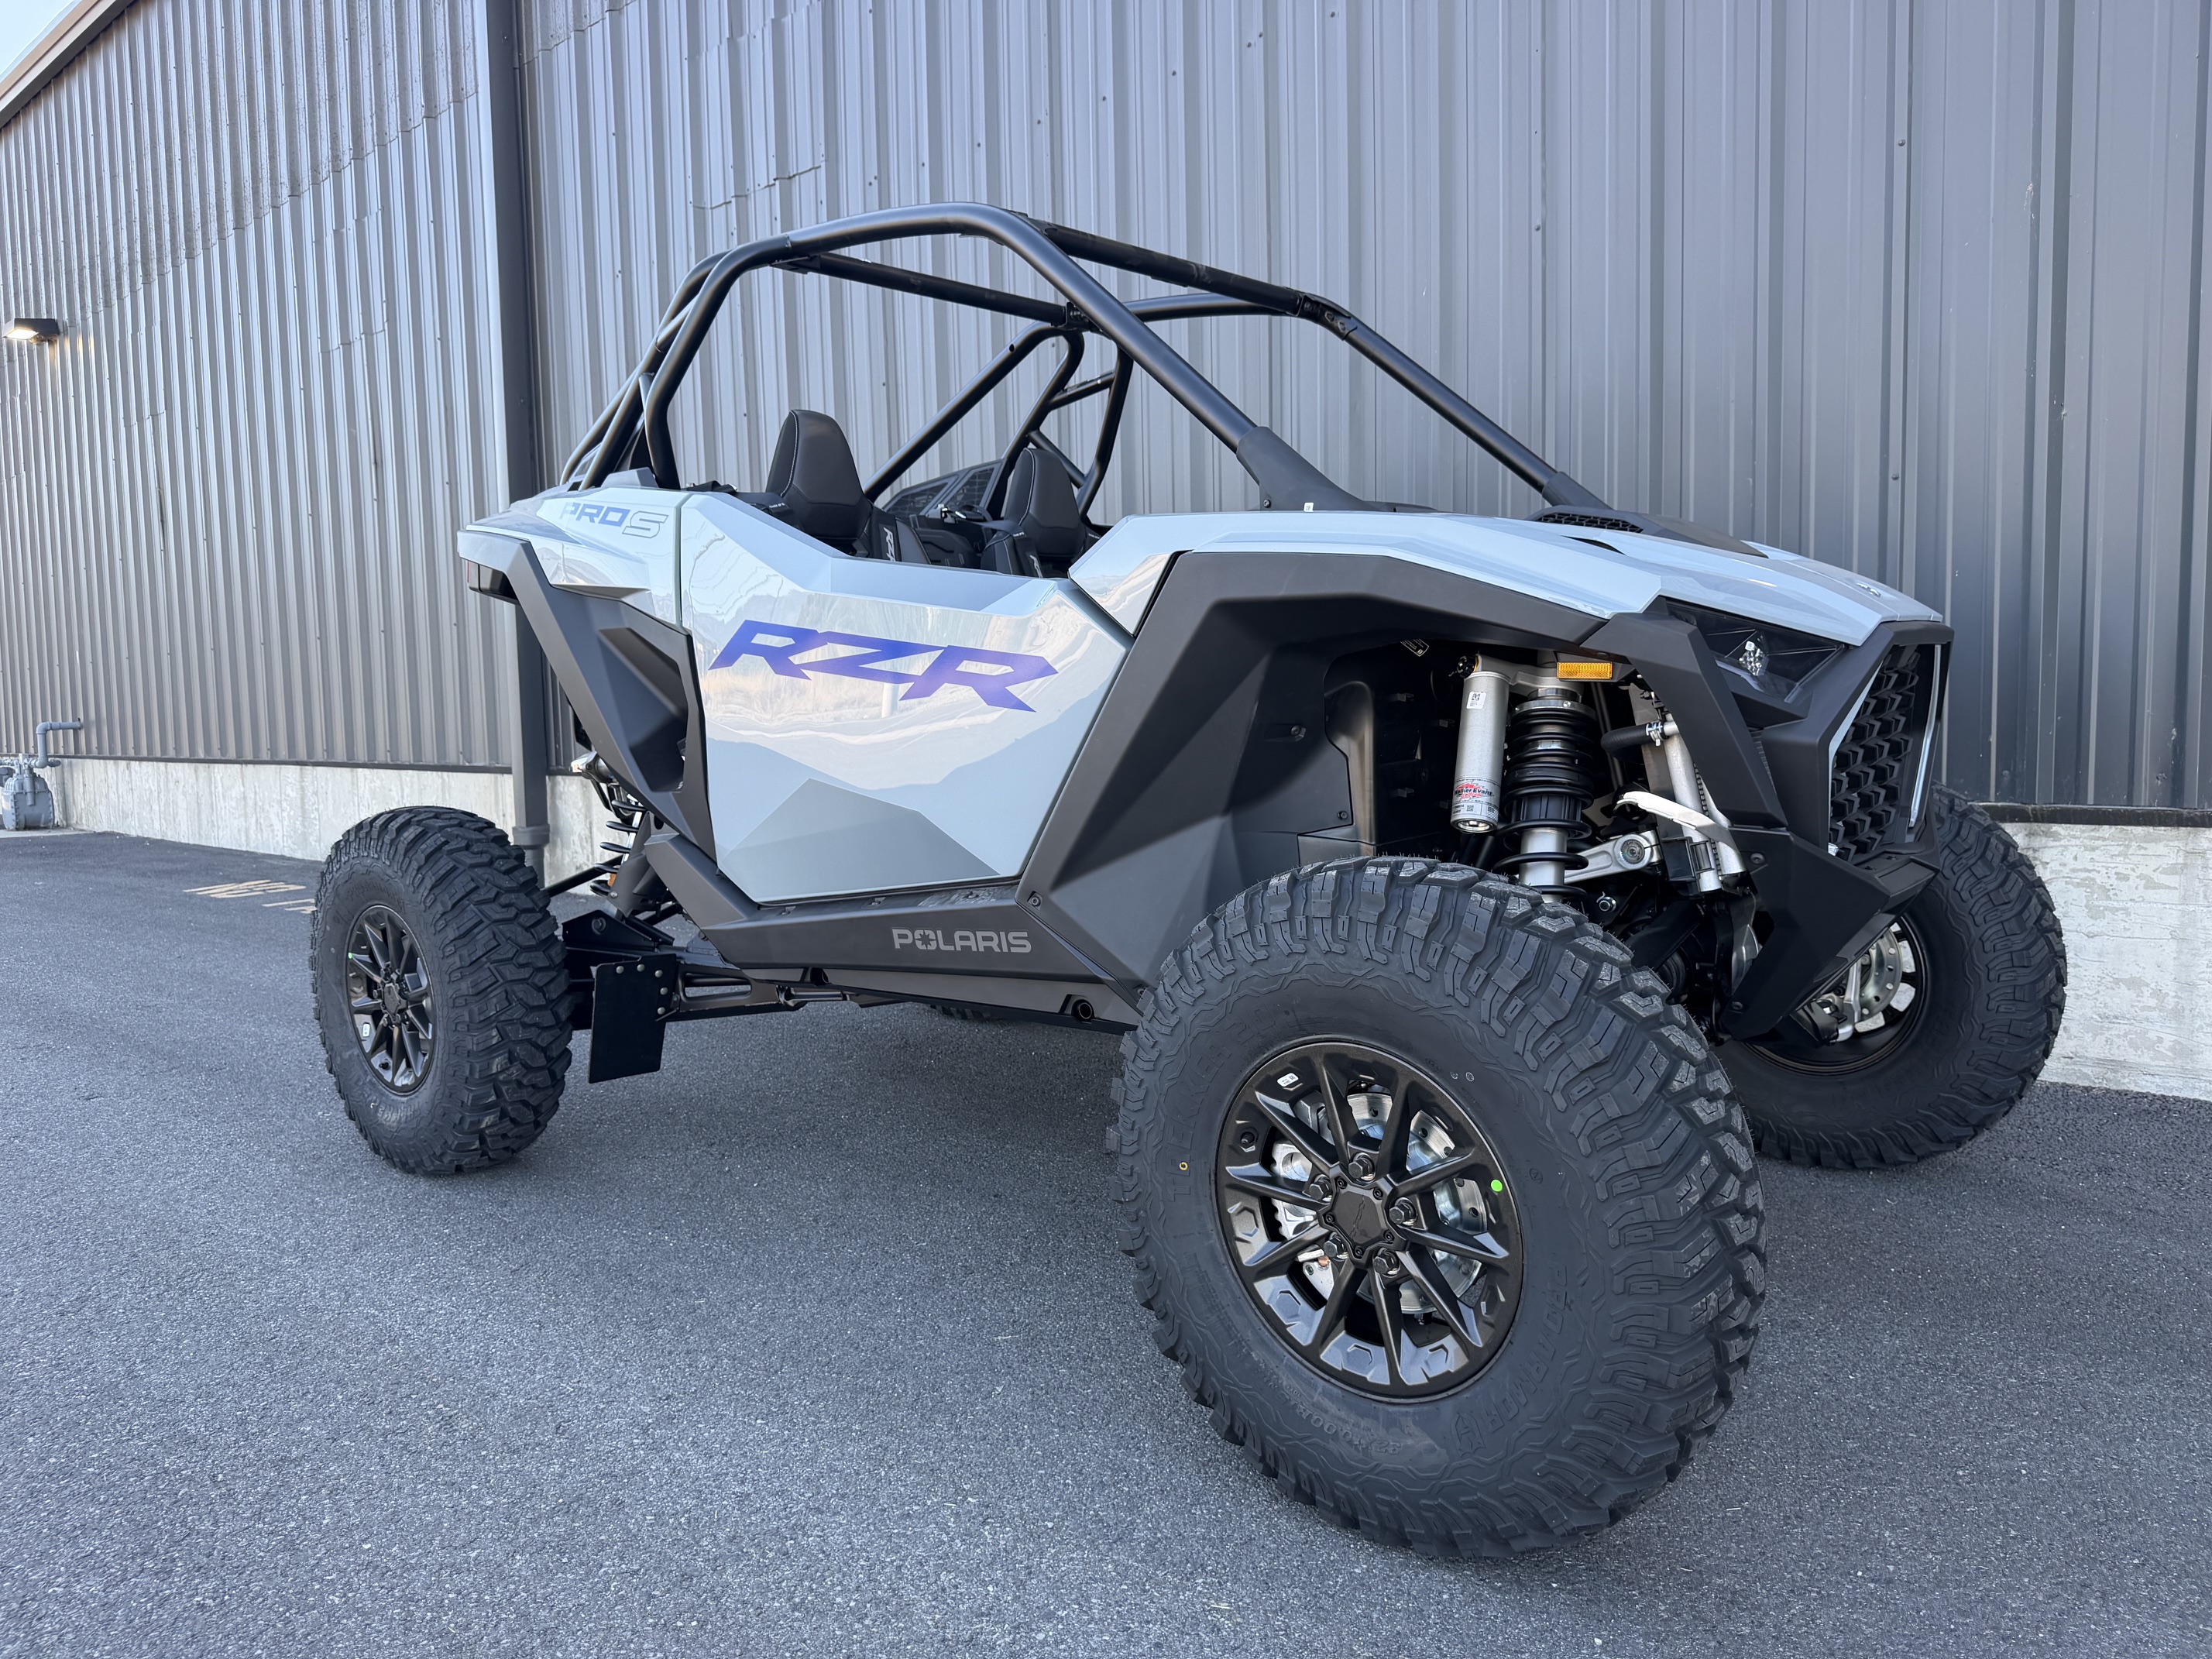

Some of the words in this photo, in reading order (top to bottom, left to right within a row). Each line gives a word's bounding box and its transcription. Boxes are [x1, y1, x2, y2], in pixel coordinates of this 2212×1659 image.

[559, 502, 632, 527] PRO
[622, 510, 668, 538] S
[708, 619, 1059, 712] RZR
[891, 928, 1032, 953] POLARIS
[1542, 1260, 1568, 1335] PRO
[1482, 1330, 1558, 1434] ARMOR
